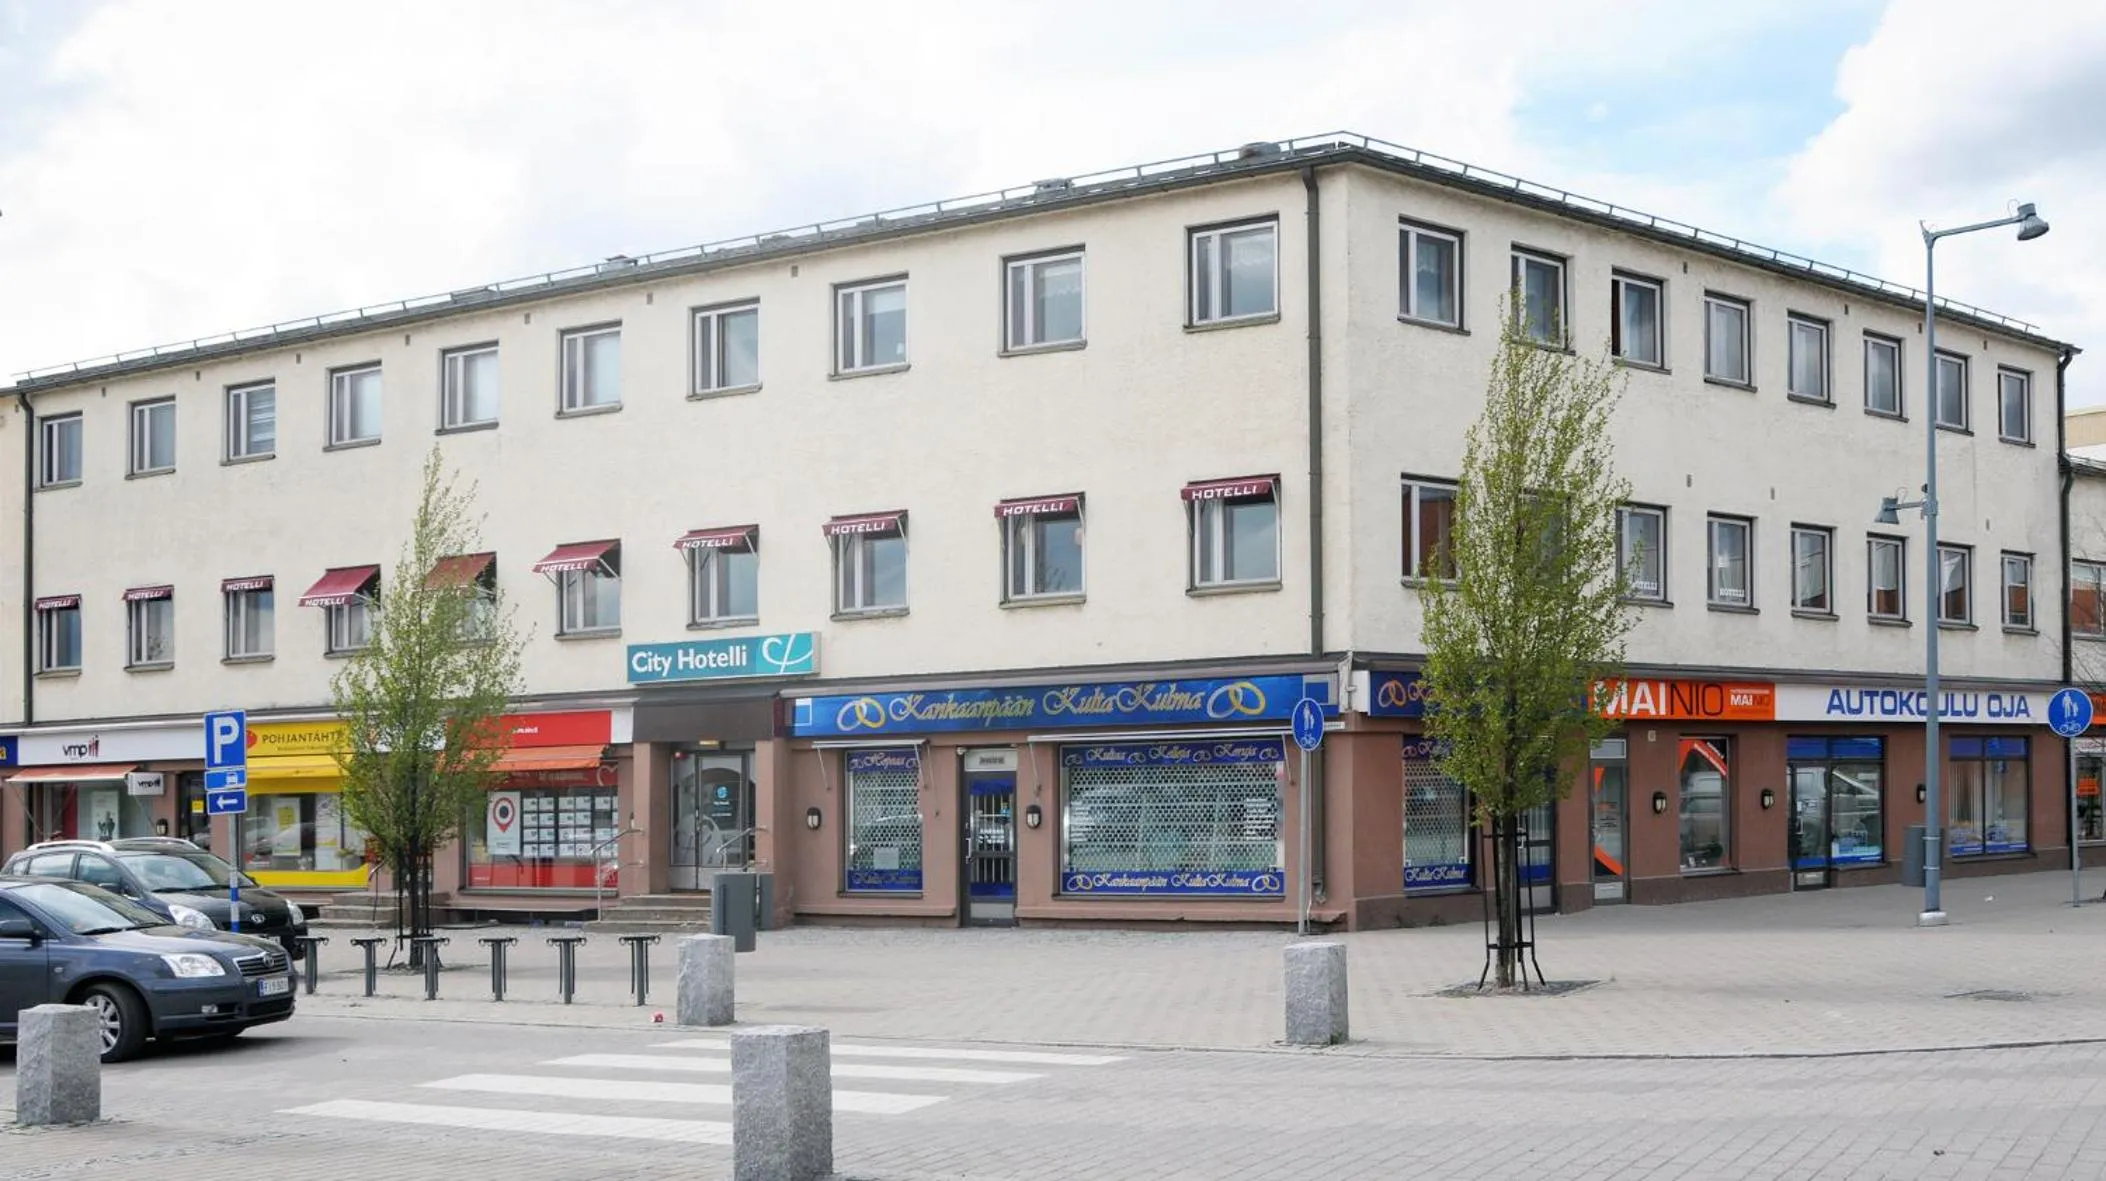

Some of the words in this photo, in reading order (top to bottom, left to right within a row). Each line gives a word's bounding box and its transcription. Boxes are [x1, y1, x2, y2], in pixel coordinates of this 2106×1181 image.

[1192, 485, 1257, 499] HOTELLI
[1003, 502, 1064, 516] HOTELLI
[831, 520, 886, 534] HOTELLI
[682, 537, 734, 549] HOTELLI
[541, 561, 588, 572] HOTELLI
[226, 581, 264, 591] HOTELLI
[305, 597, 345, 606] HOTELLI
[631, 651, 672, 677] City
[677, 645, 748, 670] Hotelli
[1594, 681, 1724, 716] MAINIO
[1826, 688, 1979, 717] AUTOKOULU
[1987, 694, 2031, 718] OJA
[213, 716, 240, 765] P
